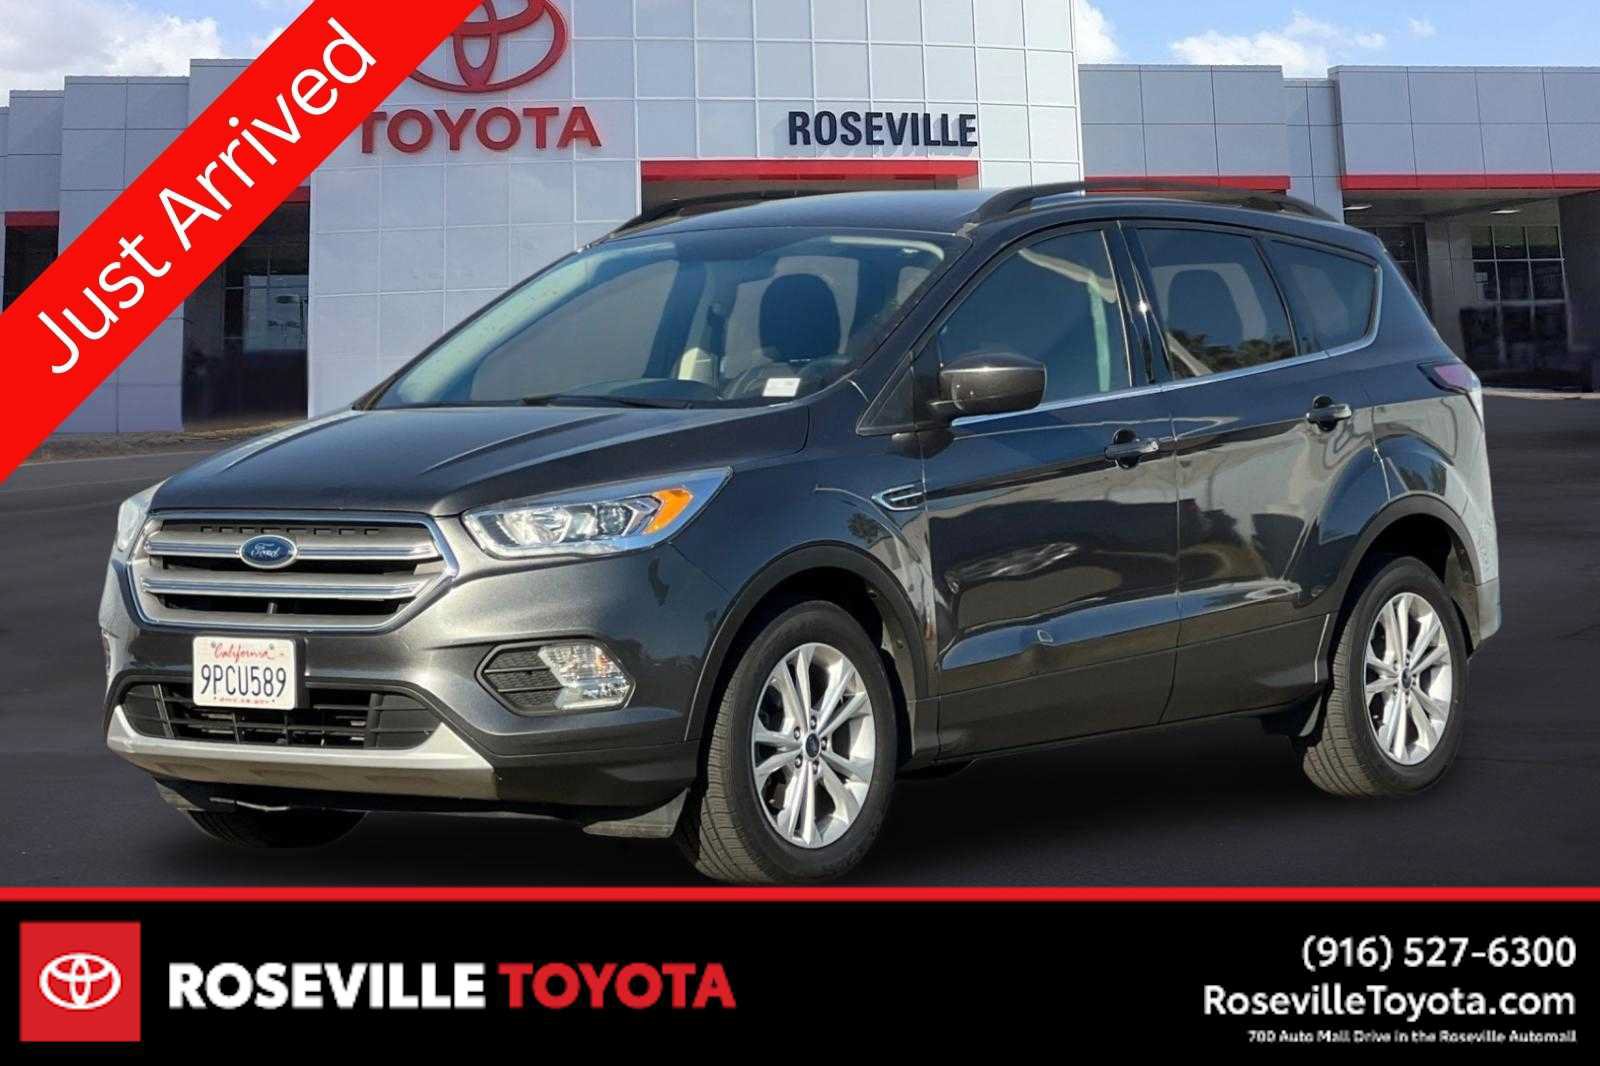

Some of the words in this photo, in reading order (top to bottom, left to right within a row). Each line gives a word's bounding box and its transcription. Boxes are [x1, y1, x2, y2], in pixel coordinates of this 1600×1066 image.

[361, 106, 602, 154] TOYOTA
[788, 110, 978, 148] ROSEVILLE
[250, 542, 281, 559] Ford
[214, 642, 275, 663] California
[200, 663, 287, 698] 9PCU589
